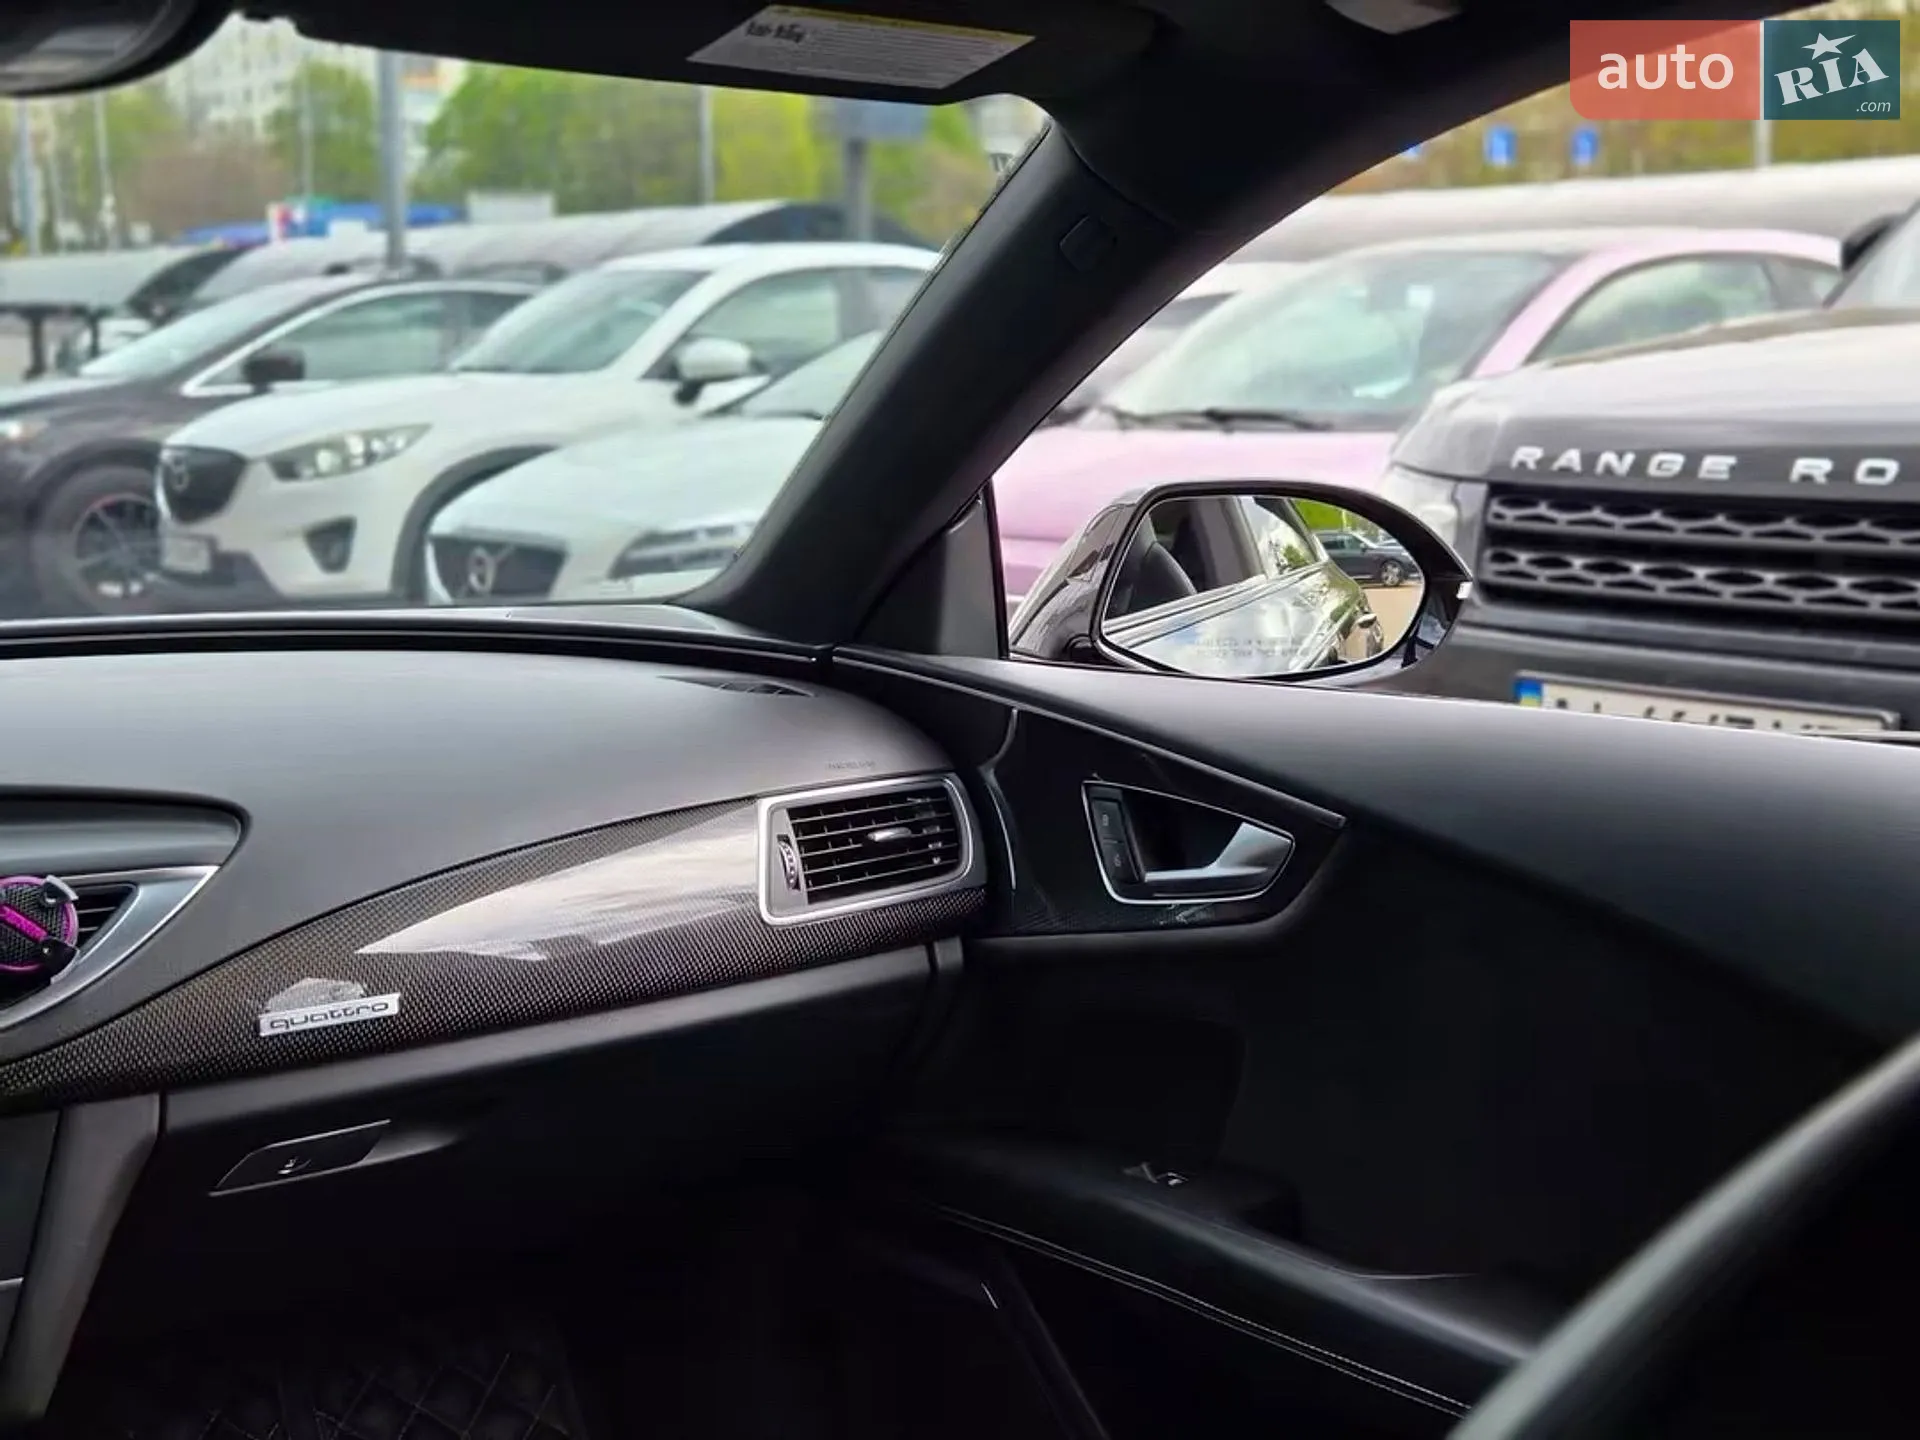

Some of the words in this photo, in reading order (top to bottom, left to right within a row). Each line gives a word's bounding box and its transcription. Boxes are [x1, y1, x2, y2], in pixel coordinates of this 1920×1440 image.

[1510, 446, 1738, 481] RANGE
[1789, 457, 1900, 486] RO
[270, 1002, 389, 1030] quattro
